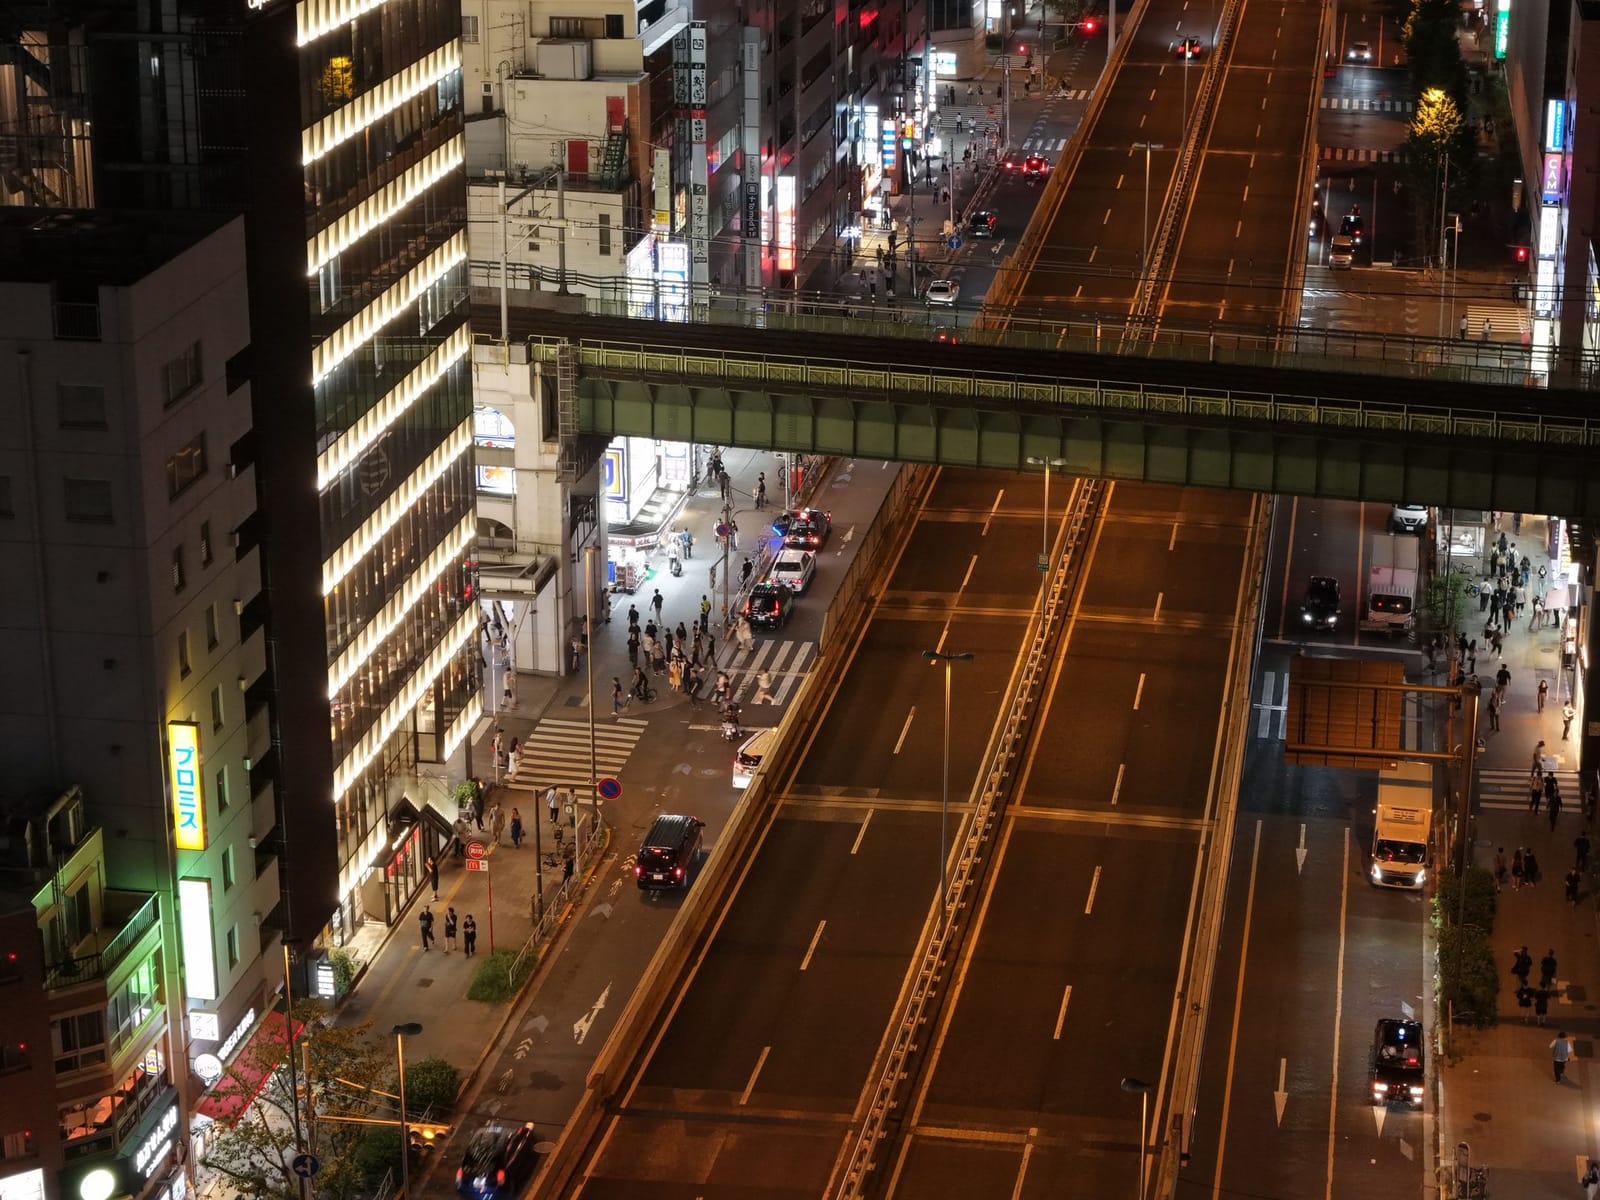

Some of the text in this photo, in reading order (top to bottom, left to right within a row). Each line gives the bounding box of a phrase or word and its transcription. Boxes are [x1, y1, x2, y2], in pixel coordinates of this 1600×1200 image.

[1546, 159, 1558, 190] CAM
[175, 746, 198, 829] プロミス
